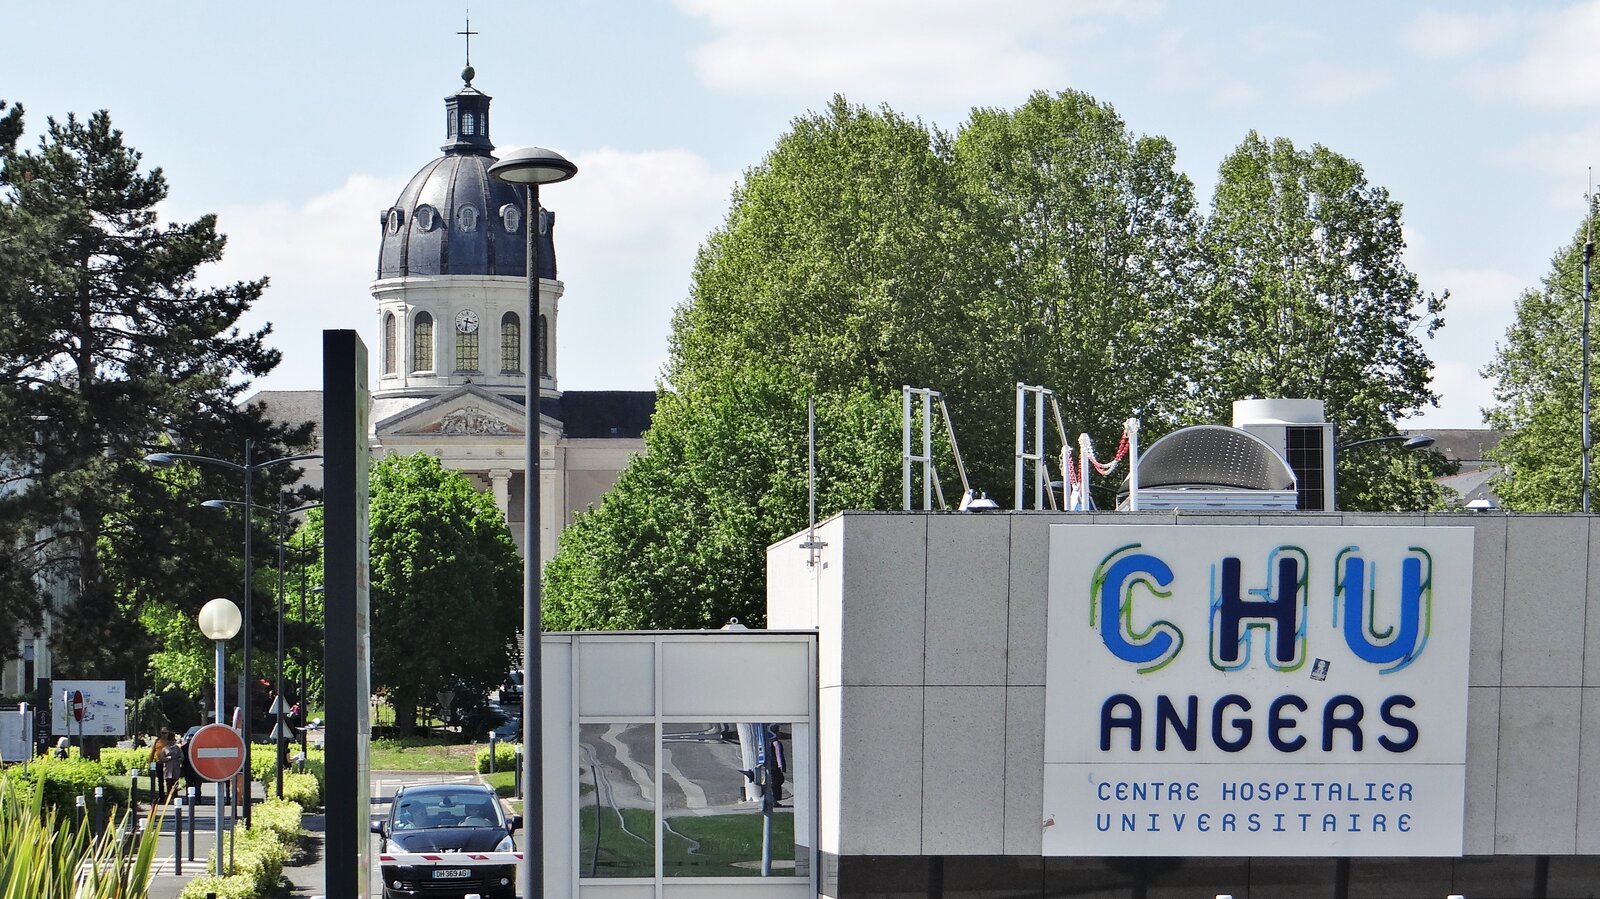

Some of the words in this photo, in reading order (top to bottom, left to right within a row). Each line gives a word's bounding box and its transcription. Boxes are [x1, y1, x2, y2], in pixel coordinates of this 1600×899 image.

[1091, 543, 1432, 675] CHU
[1100, 694, 1419, 752] ANGERS
[1097, 782, 1200, 801] CENTRE
[1222, 782, 1413, 801] HOSPITALIER
[1096, 813, 1412, 832] UNIVERSITAIRE
